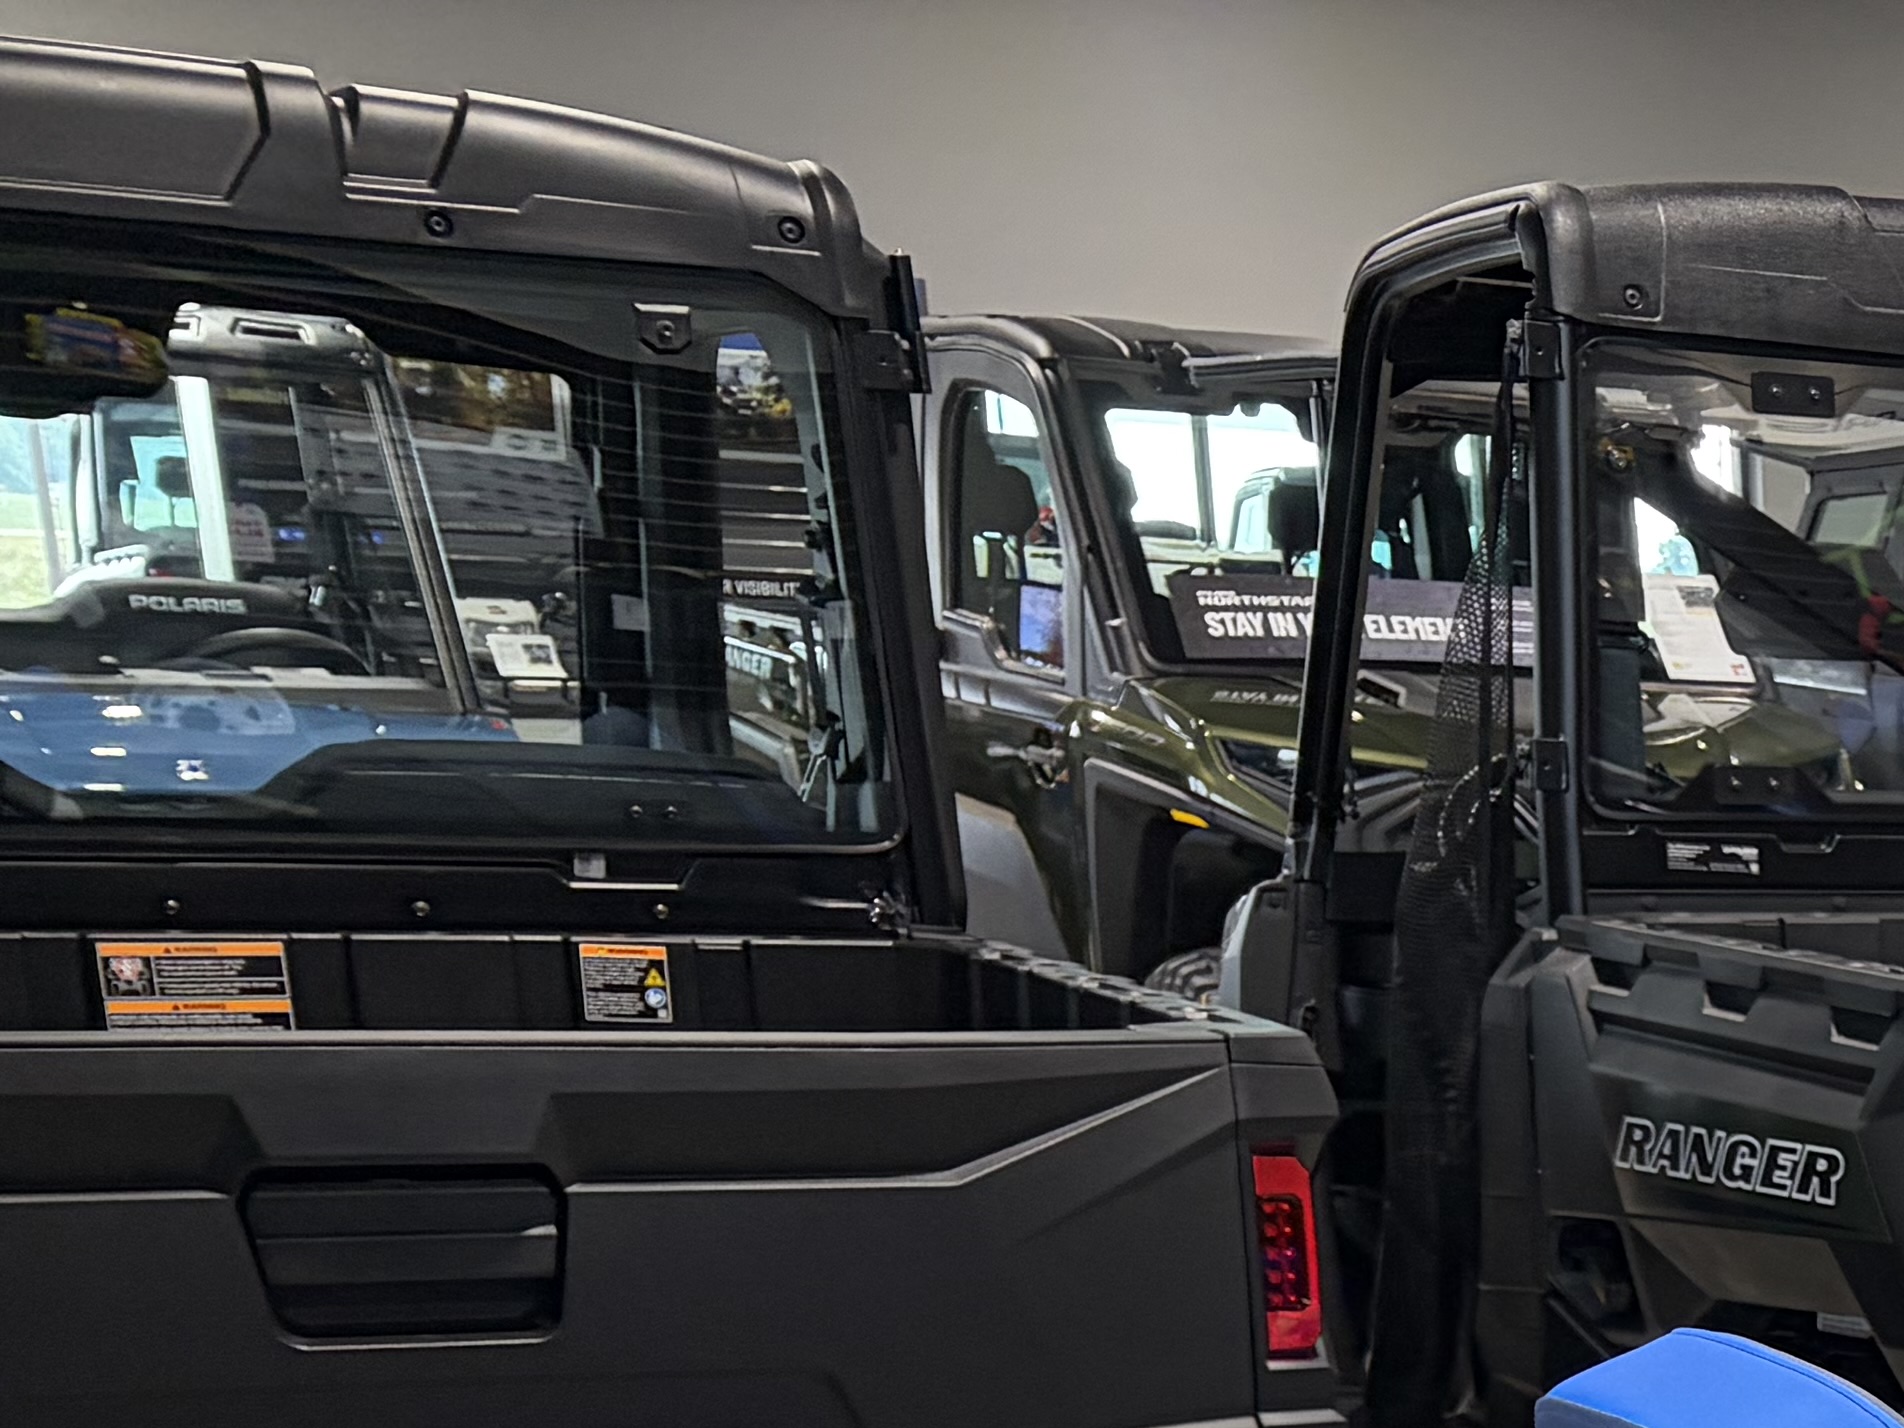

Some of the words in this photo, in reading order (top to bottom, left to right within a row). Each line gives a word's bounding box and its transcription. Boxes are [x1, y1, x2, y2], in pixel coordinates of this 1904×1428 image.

[734, 580, 800, 597] VISIBILIT
[128, 594, 248, 614] POLARIS
[1204, 611, 1264, 639] STAY
[1267, 613, 1299, 639] IN
[1614, 1115, 1845, 1206] RANGER
